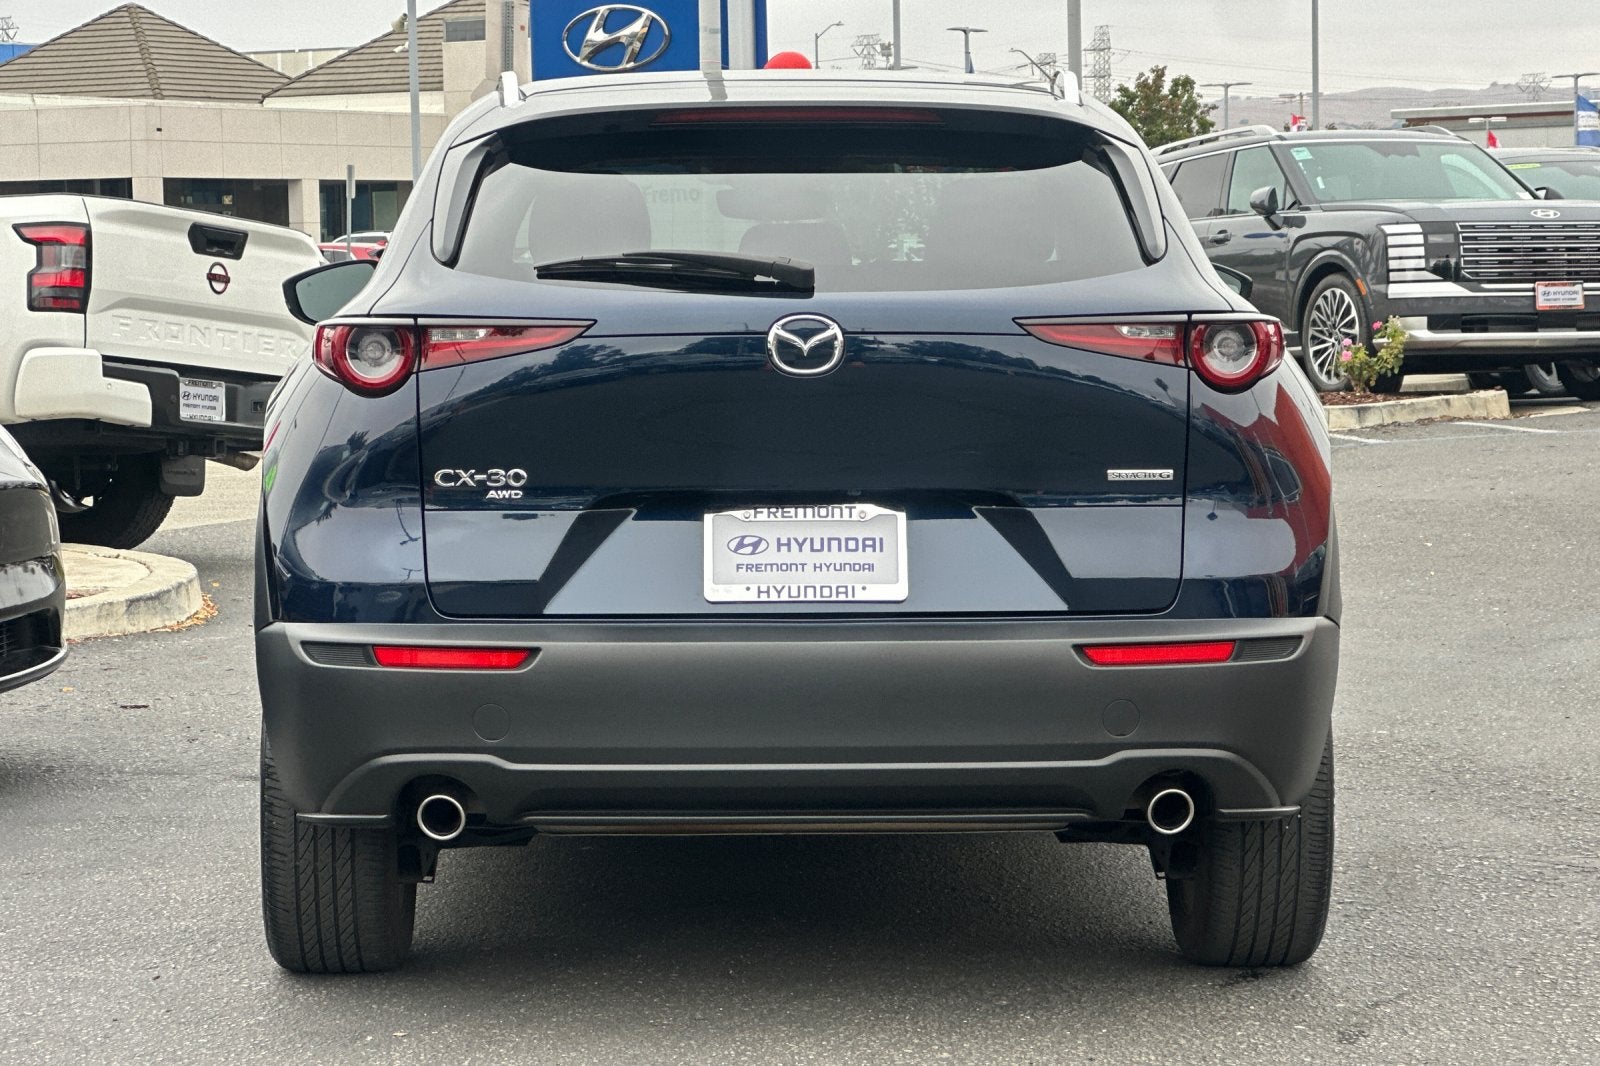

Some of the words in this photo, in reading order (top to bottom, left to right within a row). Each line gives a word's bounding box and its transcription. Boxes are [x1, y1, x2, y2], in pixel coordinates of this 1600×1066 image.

[111, 314, 298, 359] FRONTIER
[192, 393, 219, 402] HYUNDAI
[434, 468, 528, 487] CX-30
[486, 490, 523, 499] AWD
[753, 505, 857, 519] FREMONT
[776, 537, 884, 553] HYUNDAI
[736, 563, 808, 573] FREMONT
[813, 562, 875, 572] HYUNDAI
[757, 585, 856, 599] HYUNDAI
